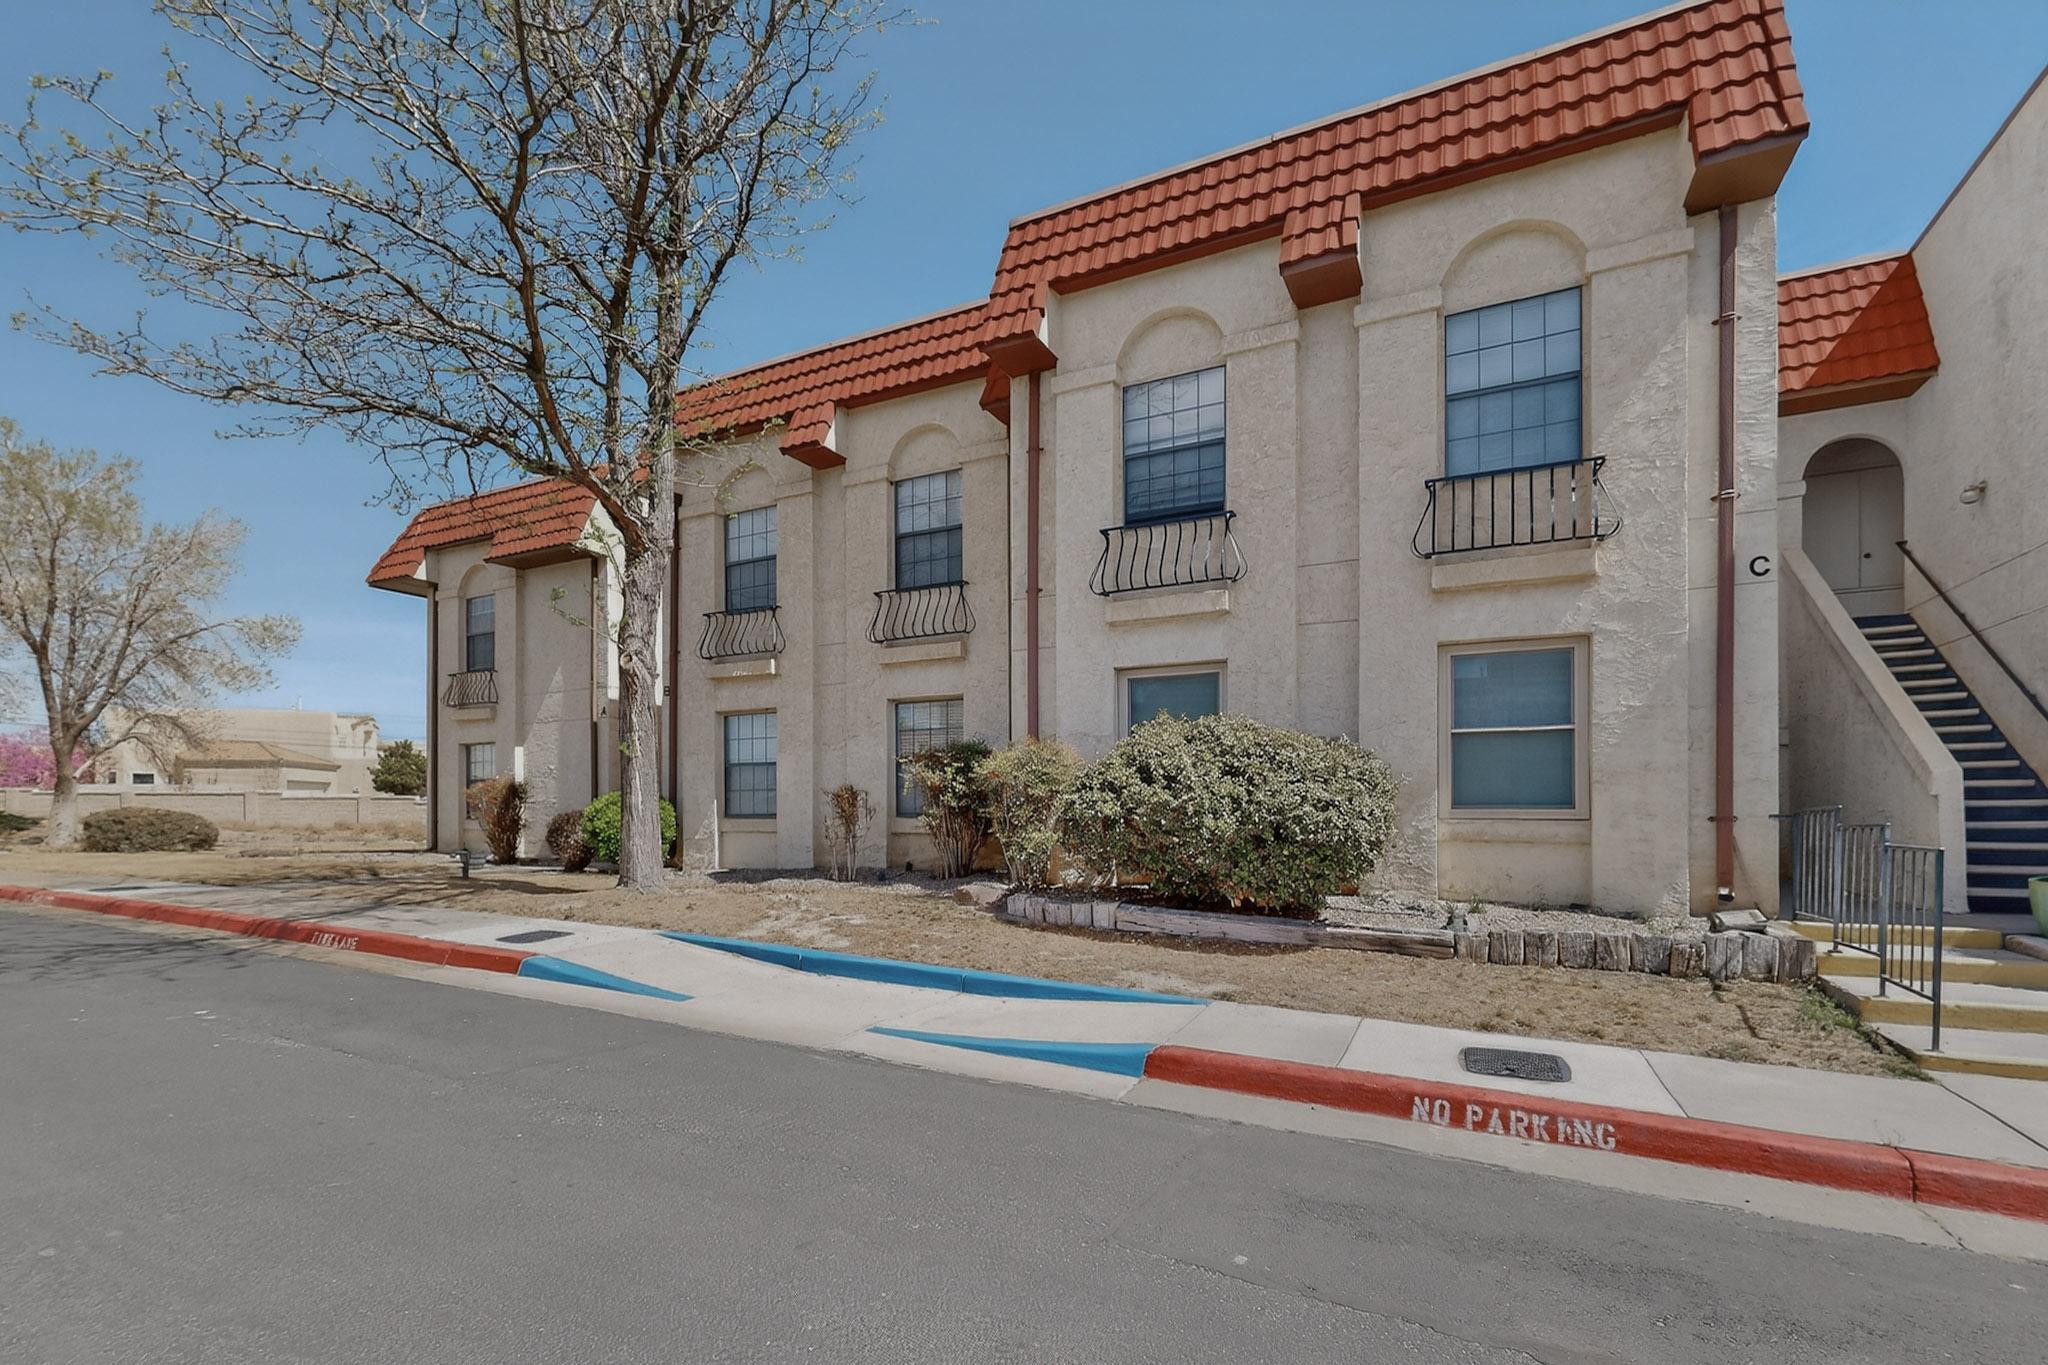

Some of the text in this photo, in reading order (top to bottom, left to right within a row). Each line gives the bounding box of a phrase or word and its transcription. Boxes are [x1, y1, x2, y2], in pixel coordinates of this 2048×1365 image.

[1749, 555, 1771, 577] C
[1412, 1096, 1616, 1150] NO PARKING
